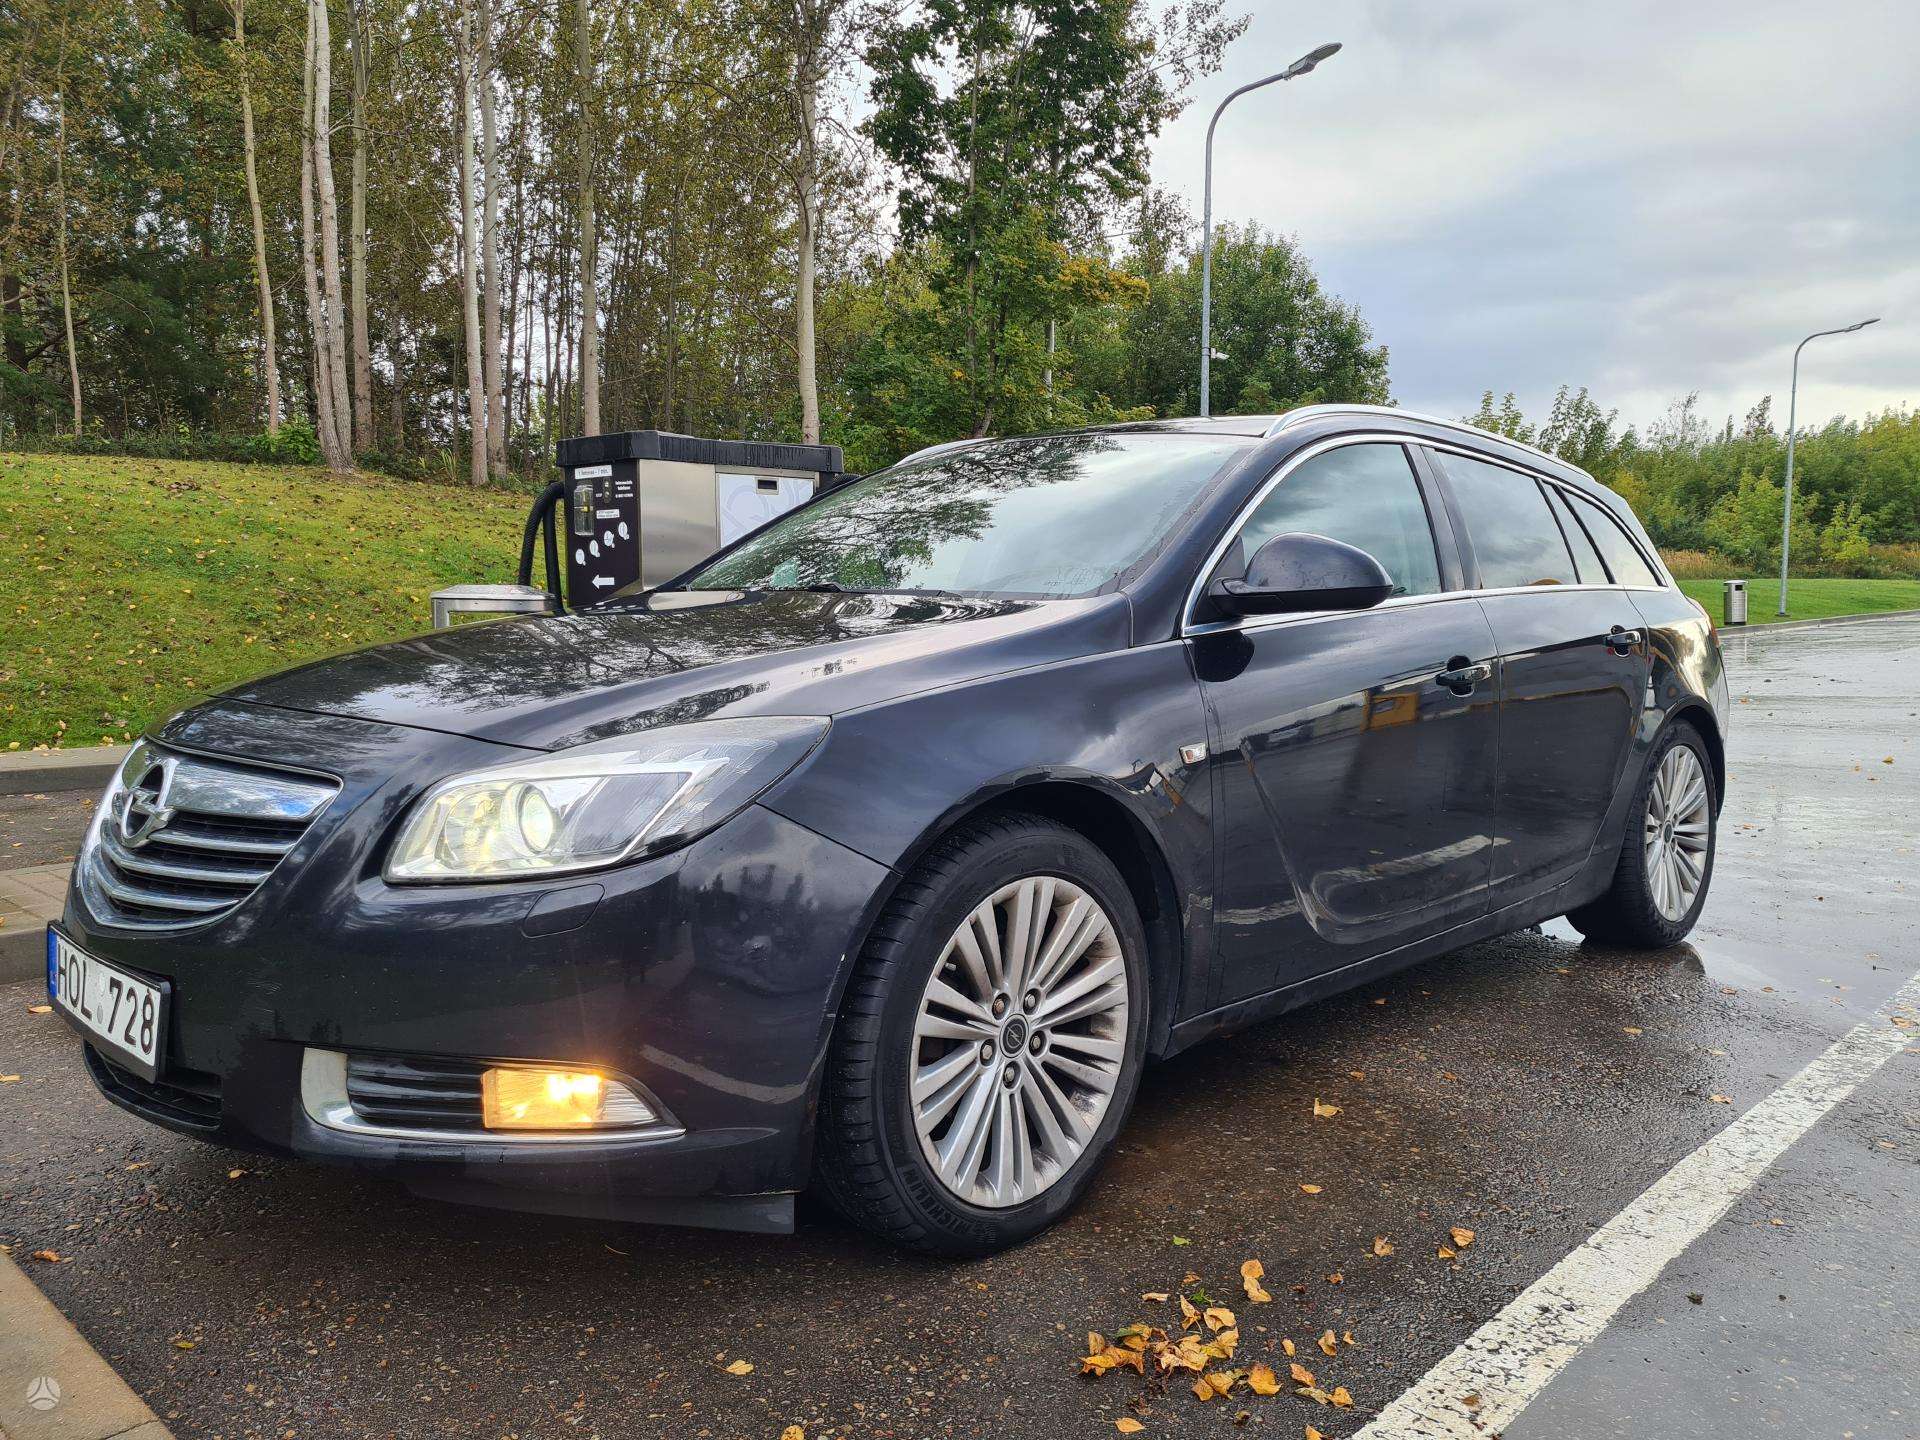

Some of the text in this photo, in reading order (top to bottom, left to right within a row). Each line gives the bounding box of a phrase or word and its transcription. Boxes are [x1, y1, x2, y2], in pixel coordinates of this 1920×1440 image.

[57, 943, 155, 1056] HOL 728
[902, 1168, 972, 1236] MICHELIN
